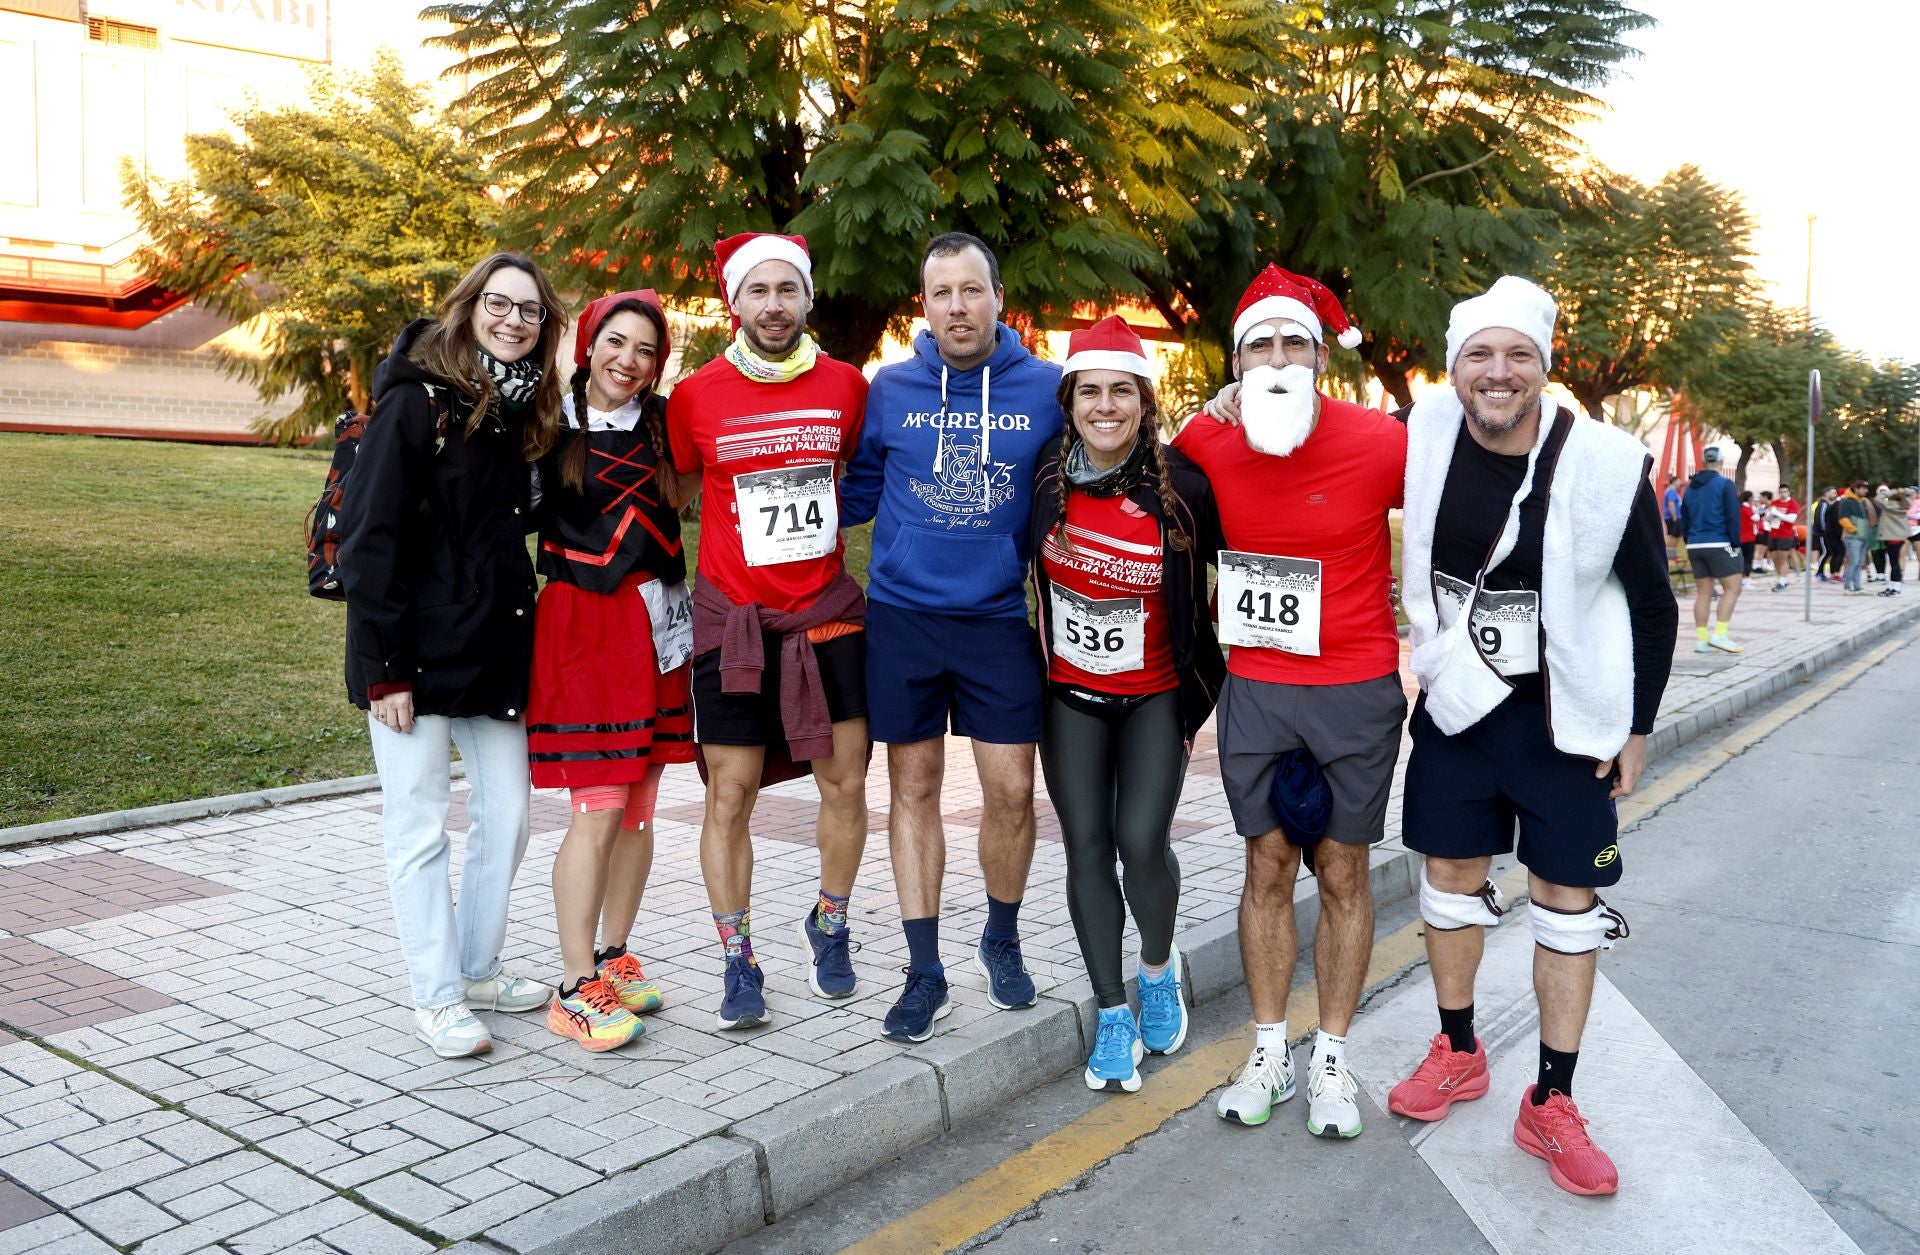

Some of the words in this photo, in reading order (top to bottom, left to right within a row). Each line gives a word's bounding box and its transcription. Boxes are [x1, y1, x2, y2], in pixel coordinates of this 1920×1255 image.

[830, 410, 842, 419] XIV
[797, 425, 842, 436] CARRERA
[779, 435, 799, 444] SAN
[801, 434, 841, 444] SILVESTRE
[753, 443, 793, 456] PALMA
[796, 441, 840, 453] PALMILLA
[990, 461, 1017, 487] 75
[759, 500, 823, 536] 714
[973, 519, 991, 528] 1921
[1060, 557, 1099, 575] PALMA
[1103, 569, 1162, 586] PALMILLA
[1087, 558, 1109, 569] SAN
[1110, 564, 1162, 578] SILVESTRE
[1107, 556, 1162, 572] CARRERA
[1288, 572, 1318, 580] XIV
[1236, 588, 1299, 626] 418
[1066, 617, 1124, 652] 536
